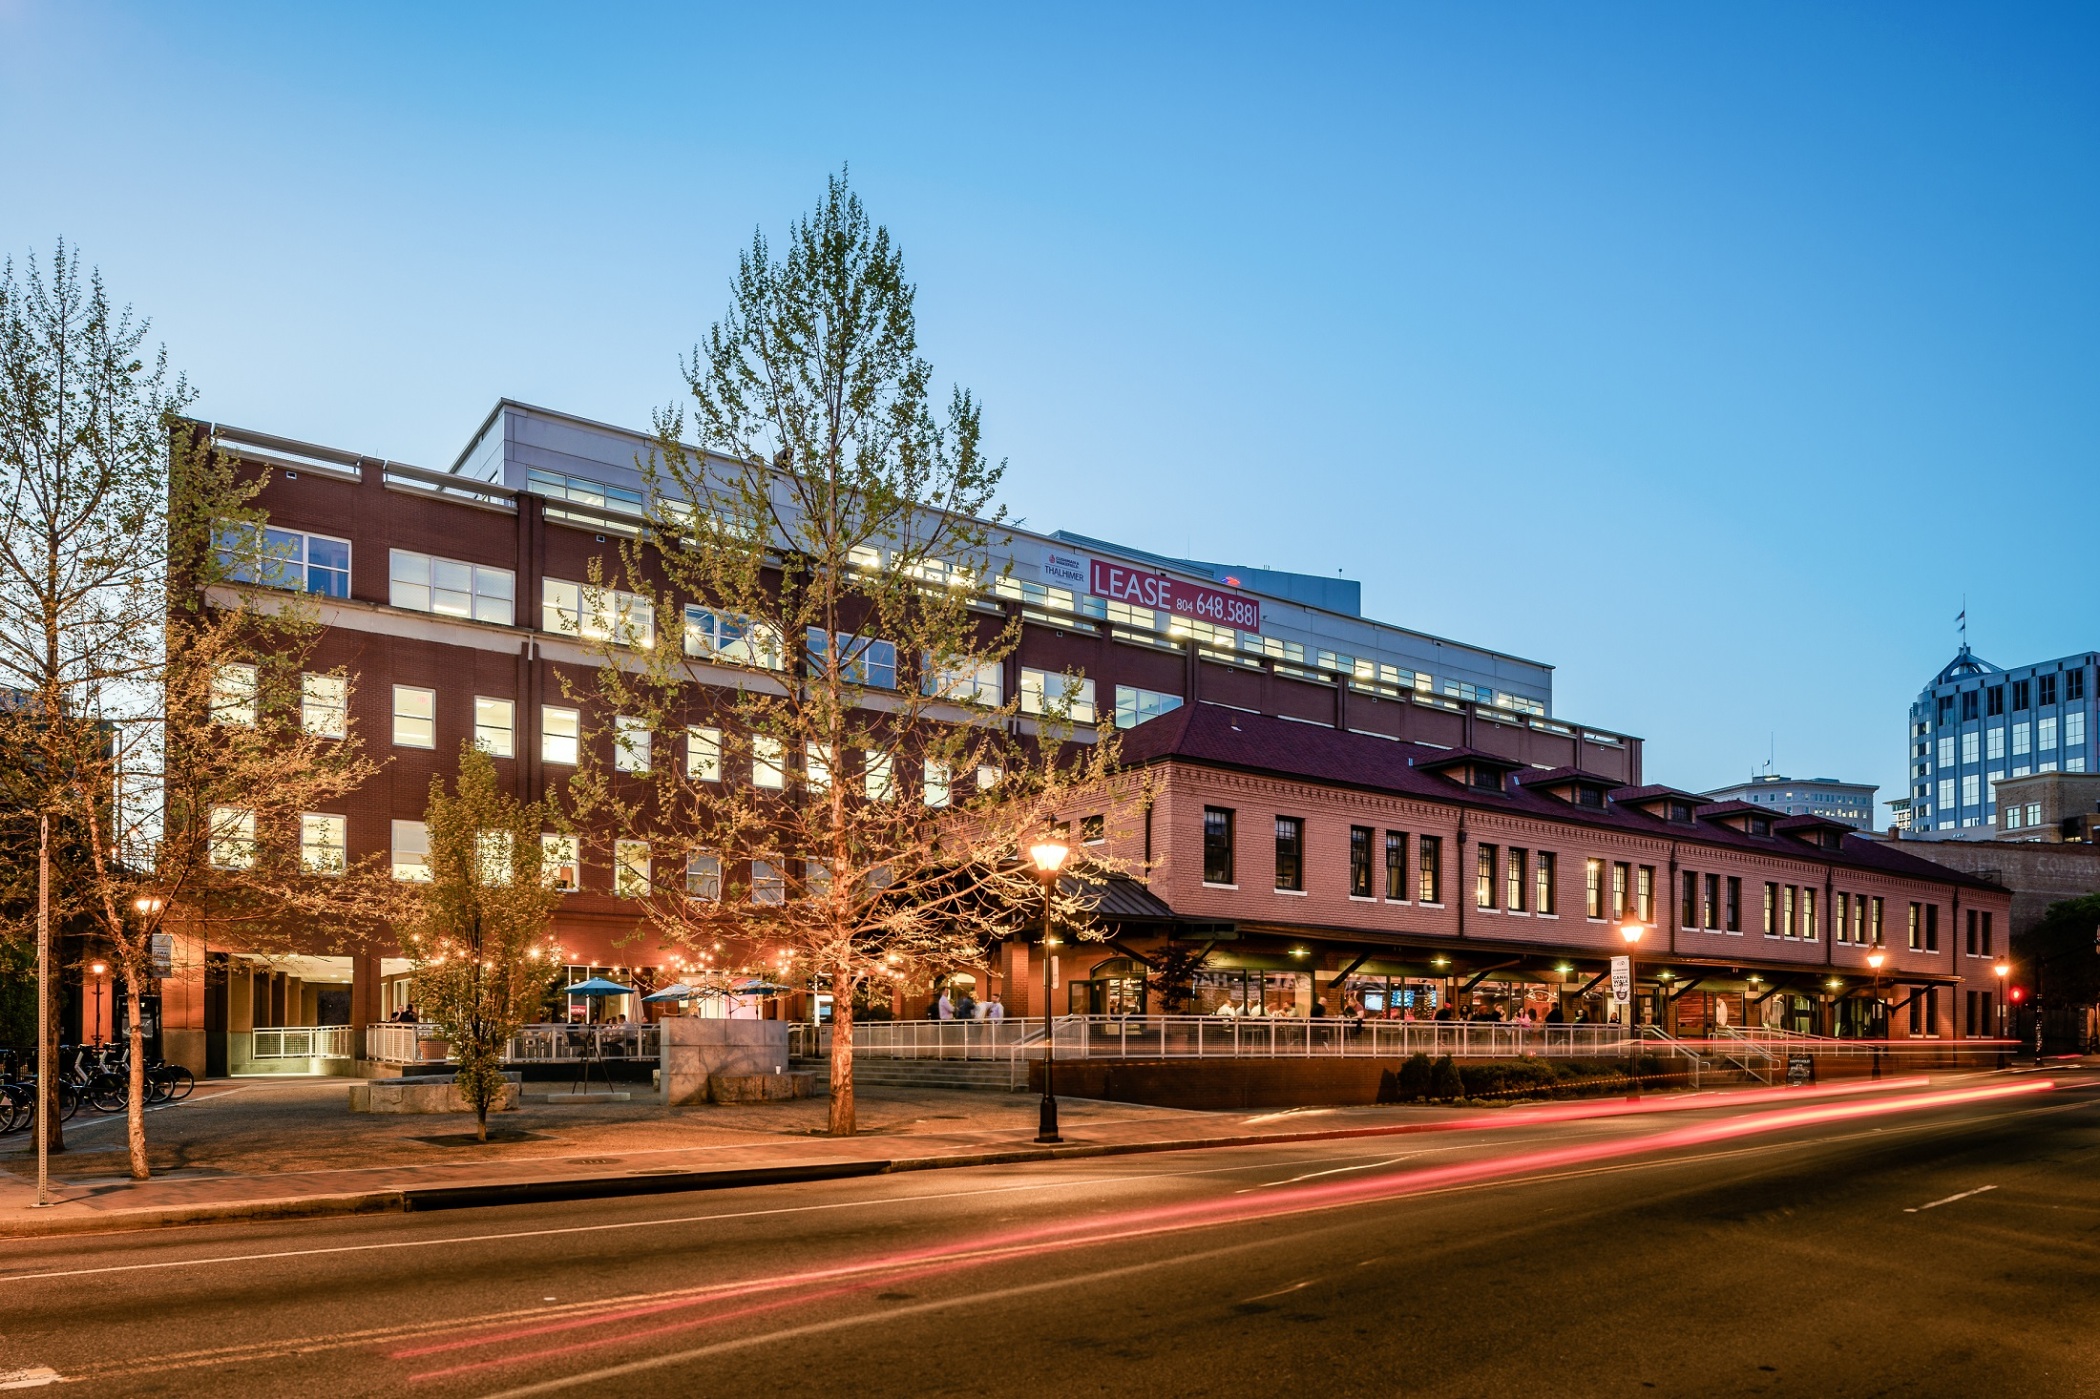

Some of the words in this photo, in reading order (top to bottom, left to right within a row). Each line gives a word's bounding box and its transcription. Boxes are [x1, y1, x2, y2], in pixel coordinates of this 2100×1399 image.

[1044, 565, 1084, 582] THALHIMER
[1095, 564, 1171, 610] LEASE
[1176, 597, 1193, 613] 804
[1196, 592, 1257, 628] 648.5881
